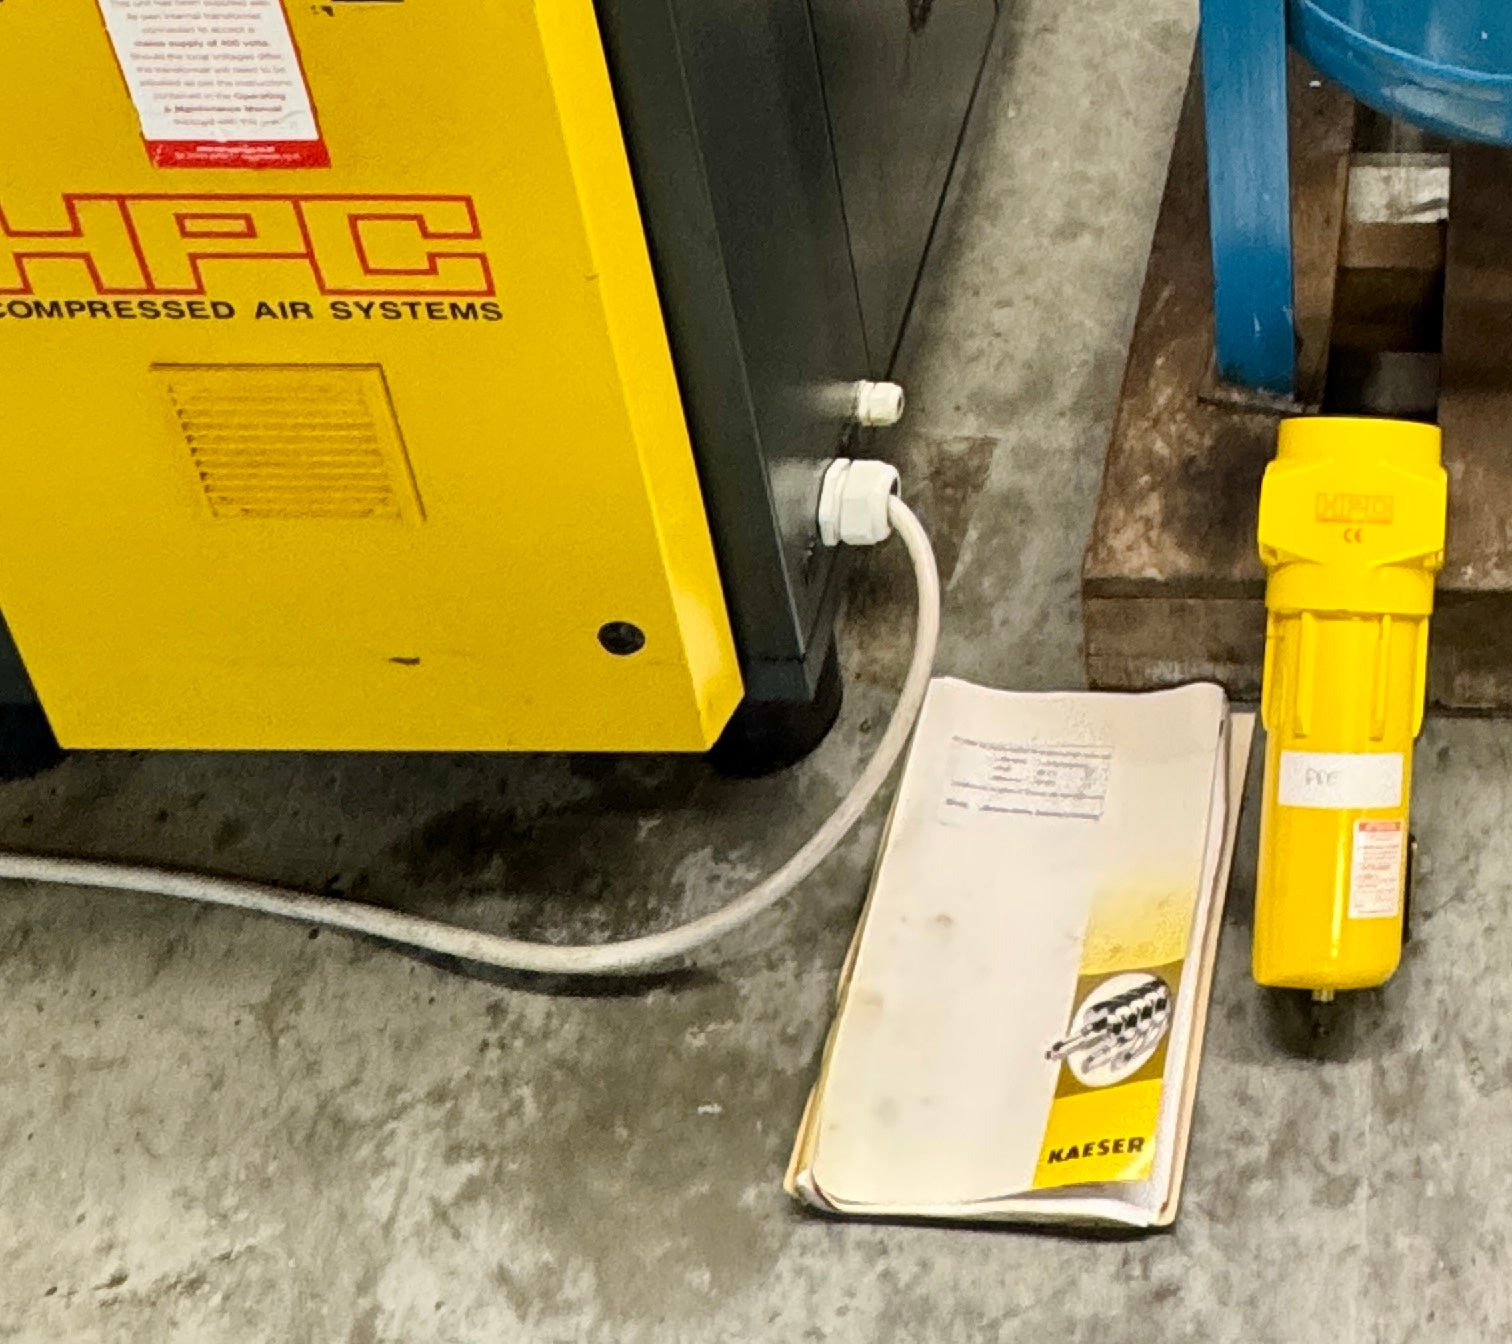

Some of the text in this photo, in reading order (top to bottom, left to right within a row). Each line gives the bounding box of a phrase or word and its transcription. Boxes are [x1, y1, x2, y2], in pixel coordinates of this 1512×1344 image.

[0, 192, 497, 296] HPC
[254, 301, 314, 320] AIR
[332, 301, 504, 321] SYSTEMS
[1046, 1134, 1146, 1165] KAESER
